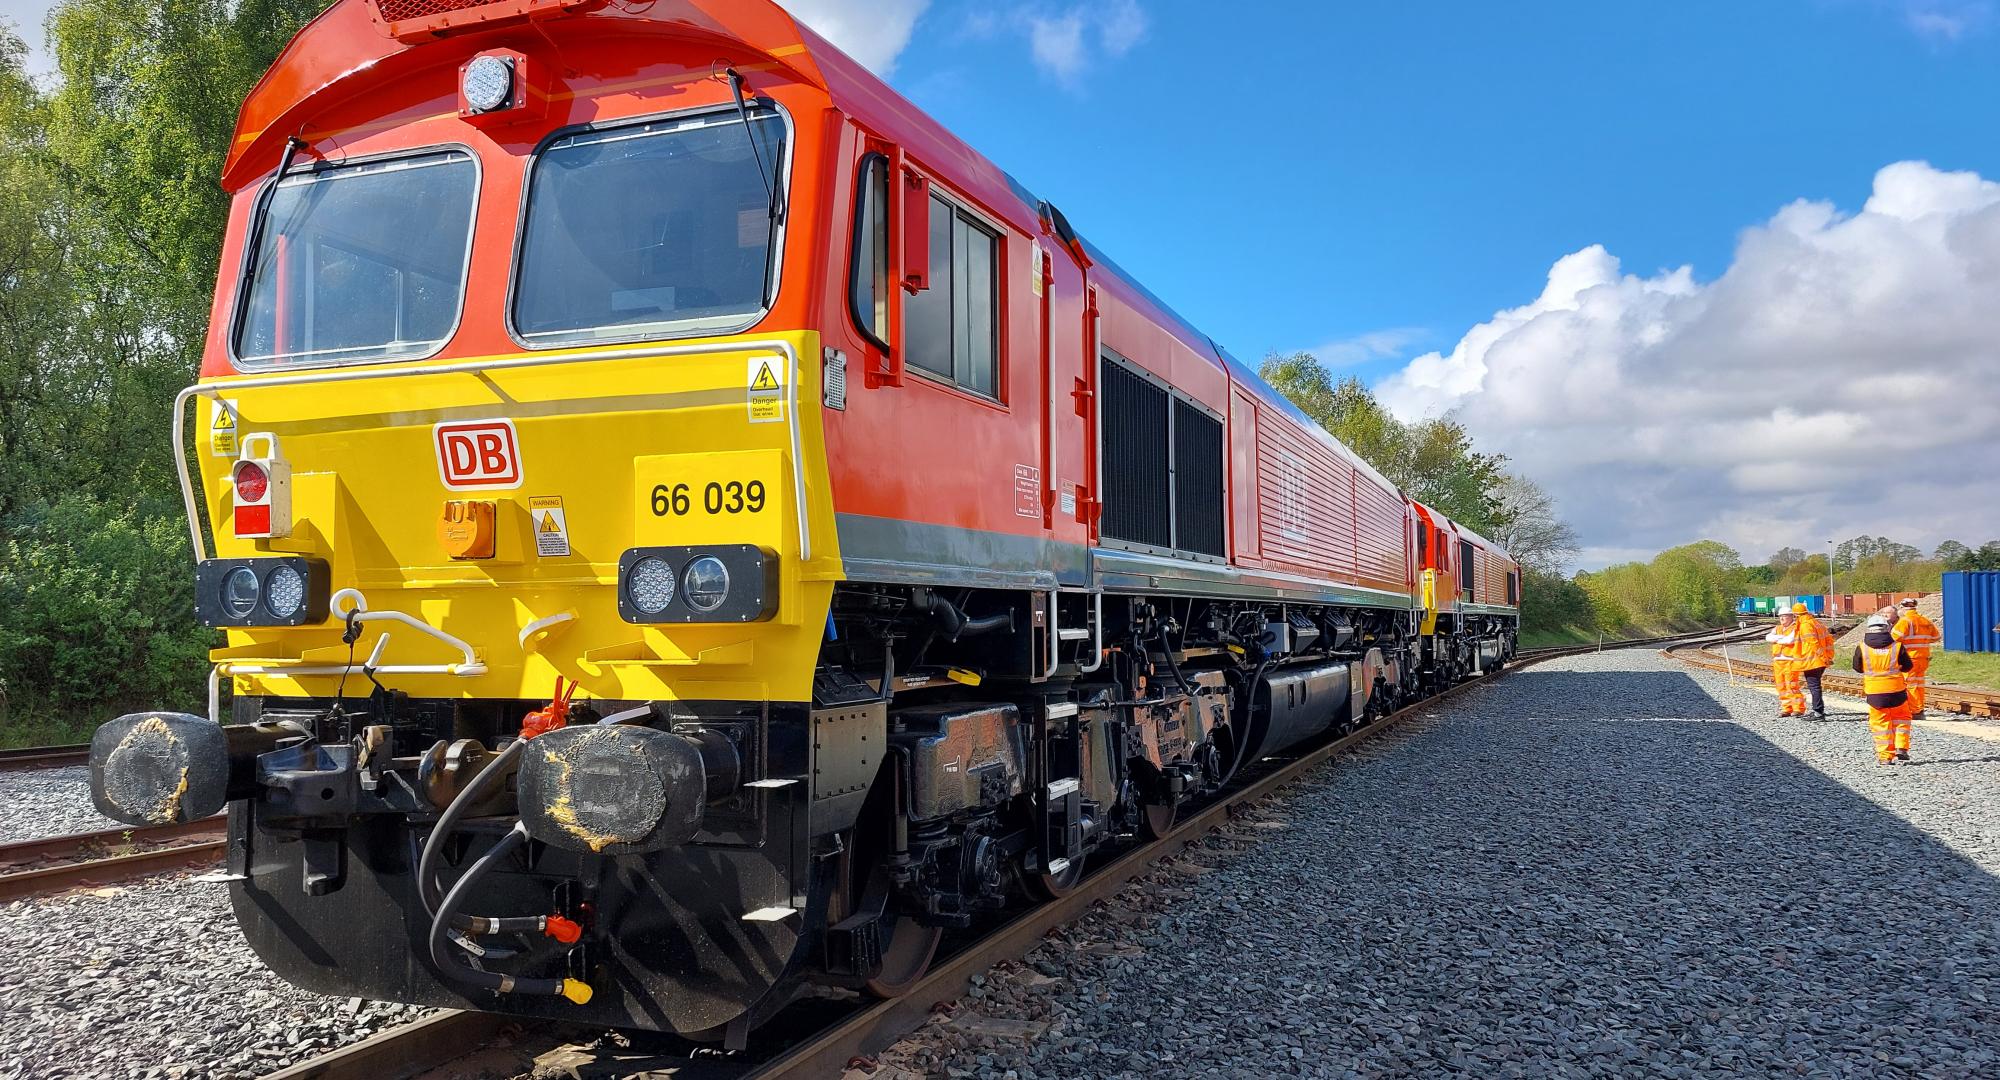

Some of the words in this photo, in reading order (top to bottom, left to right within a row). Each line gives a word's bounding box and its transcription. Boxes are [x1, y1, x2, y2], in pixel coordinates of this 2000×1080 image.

[447, 433, 507, 475] DB
[651, 484, 690, 517] 66
[704, 480, 765, 515] 039
